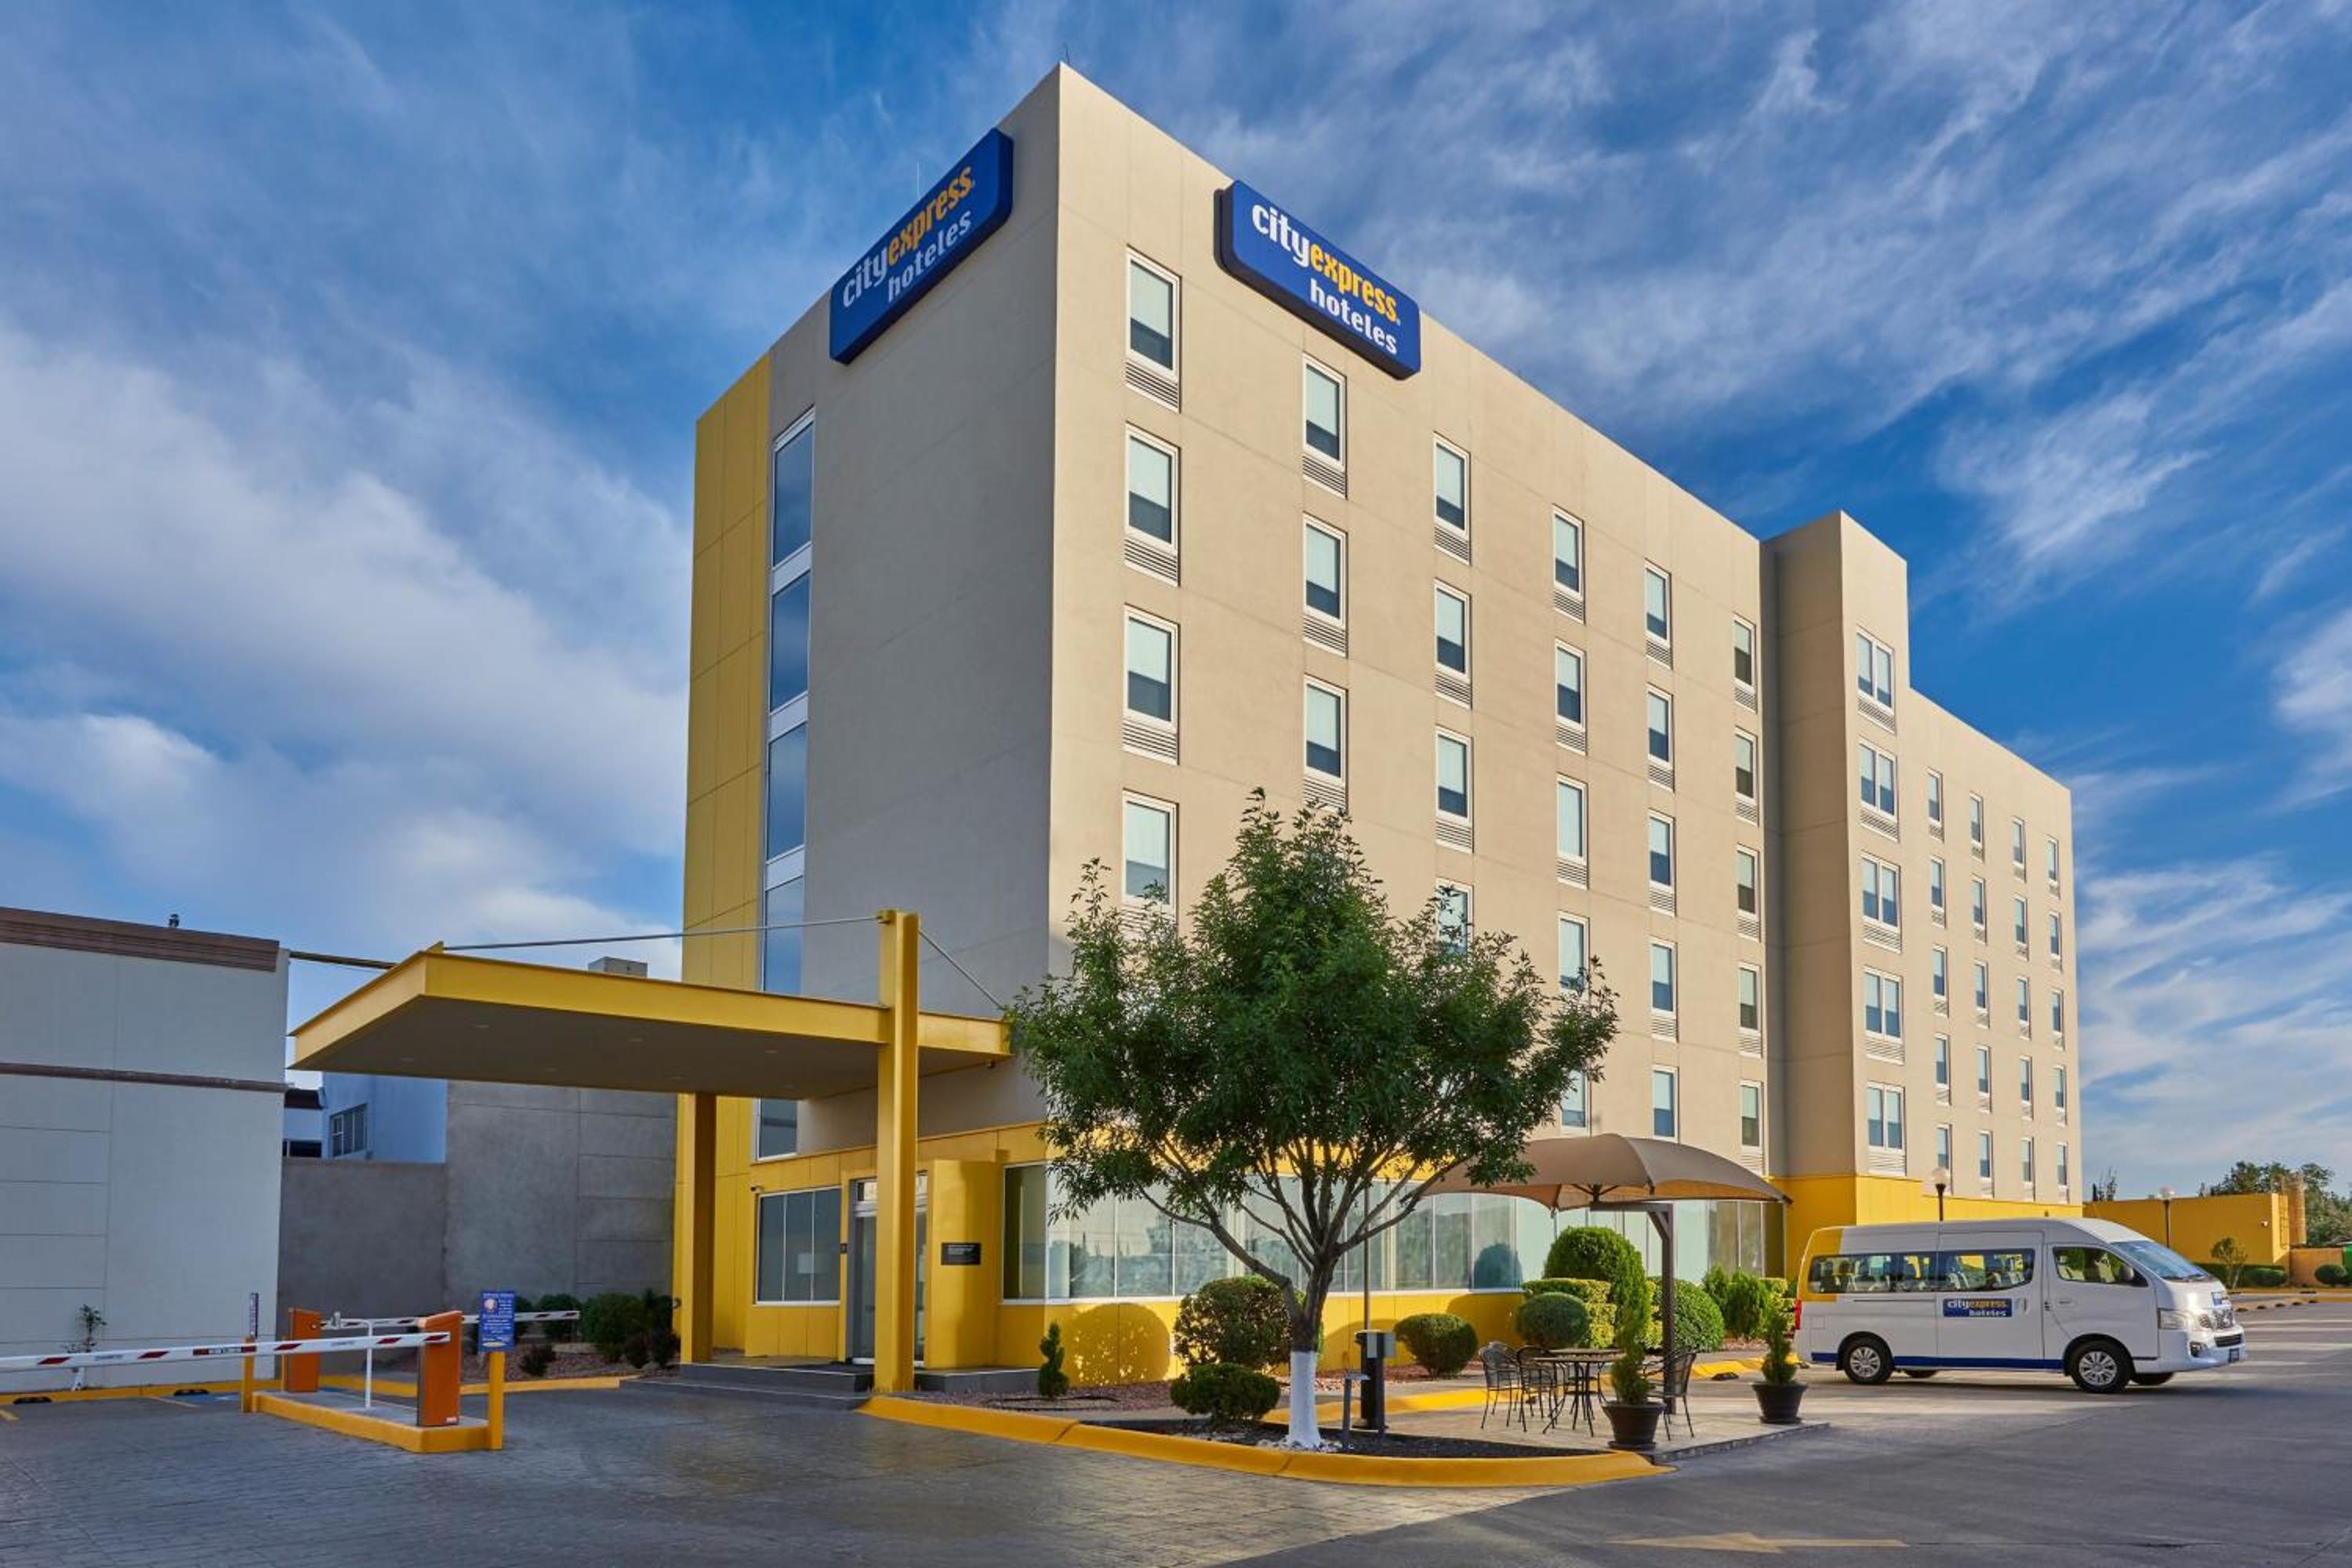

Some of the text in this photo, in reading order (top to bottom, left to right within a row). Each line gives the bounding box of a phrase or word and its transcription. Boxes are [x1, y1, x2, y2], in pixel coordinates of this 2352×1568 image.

[843, 165, 973, 307] cityexpress
[887, 210, 972, 303] hoteles
[1252, 205, 1399, 323] cityexpress
[1311, 278, 1398, 355] hoteles
